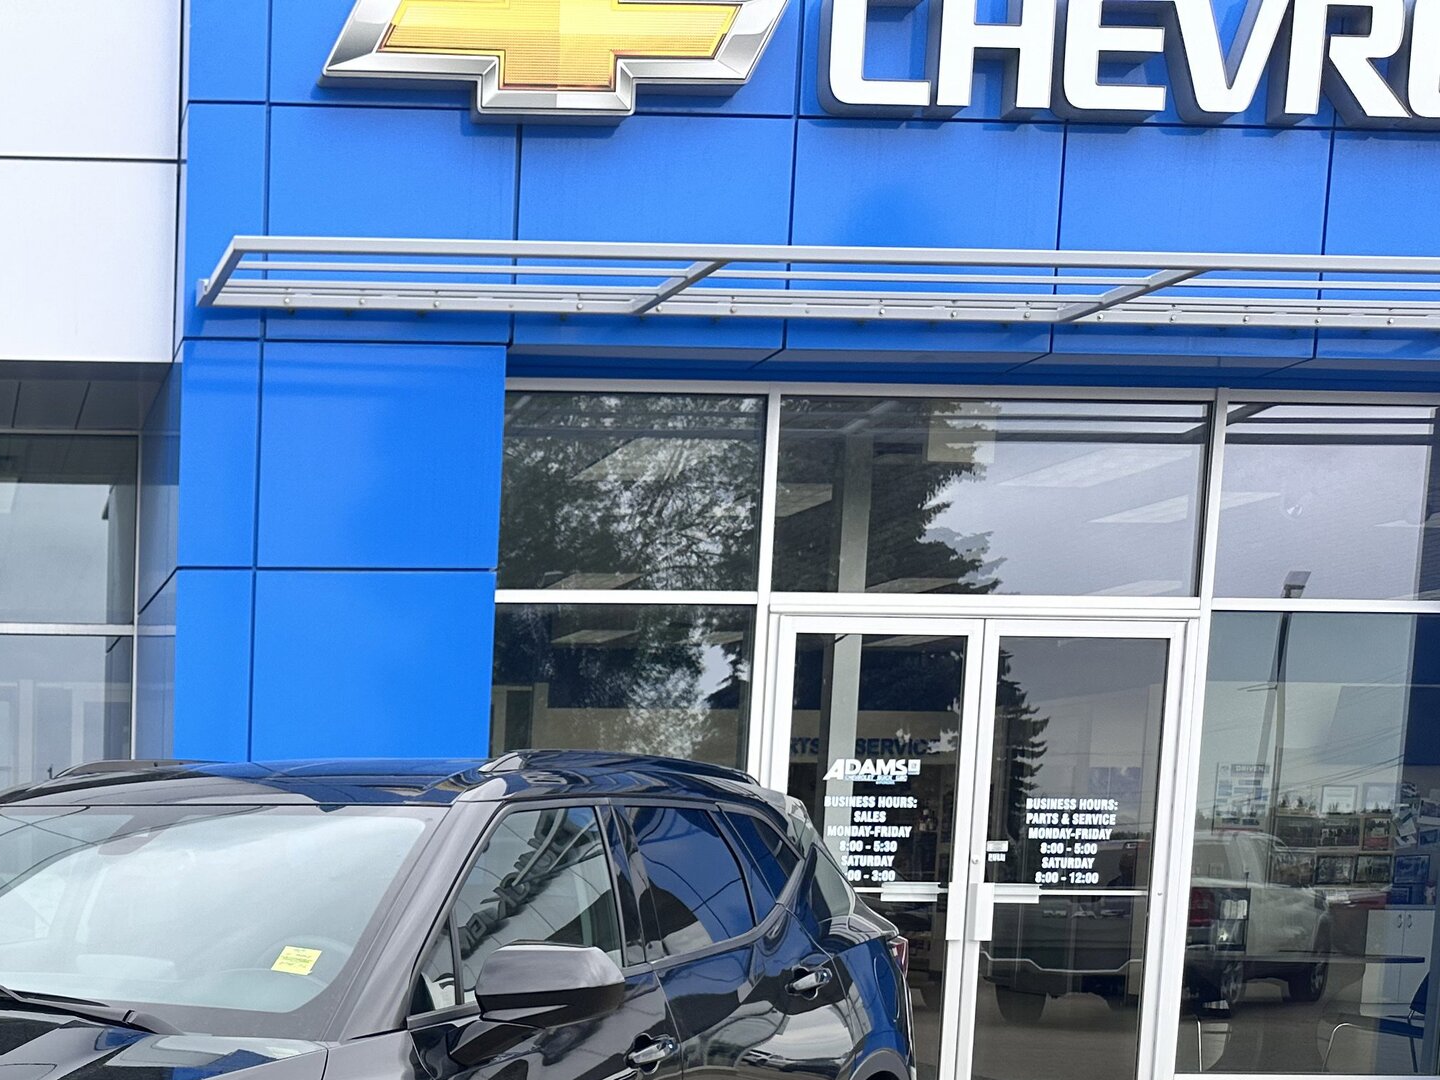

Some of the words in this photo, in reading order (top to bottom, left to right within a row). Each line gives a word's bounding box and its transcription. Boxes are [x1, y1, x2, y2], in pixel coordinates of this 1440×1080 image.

[823, 758, 908, 781] ADAMS
[824, 796, 876, 808] BUSINESS
[878, 797, 918, 809] HOURS:
[1026, 798, 1077, 810] BUSINESS
[1079, 799, 1119, 811] HOURS:
[853, 811, 887, 823] SALES
[1026, 813, 1059, 824] PARTS
[1061, 813, 1070, 825] &
[1072, 814, 1116, 825] SERVICE
[827, 826, 912, 838] MONDAY-FRIDAY
[1028, 828, 1113, 840] MONDAY-FRIDAY
[839, 841, 864, 852] 8:00
[873, 841, 898, 852] 5:30
[1040, 843, 1064, 854] 8:00
[1074, 843, 1098, 855] 5:00
[841, 855, 895, 867] SATURDAY
[1041, 857, 1095, 869] SATURDAY
[844, 870, 862, 882] :00
[871, 870, 896, 882] 3:00
[1035, 872, 1059, 884] 8:00
[1069, 872, 1099, 884] 12:00
